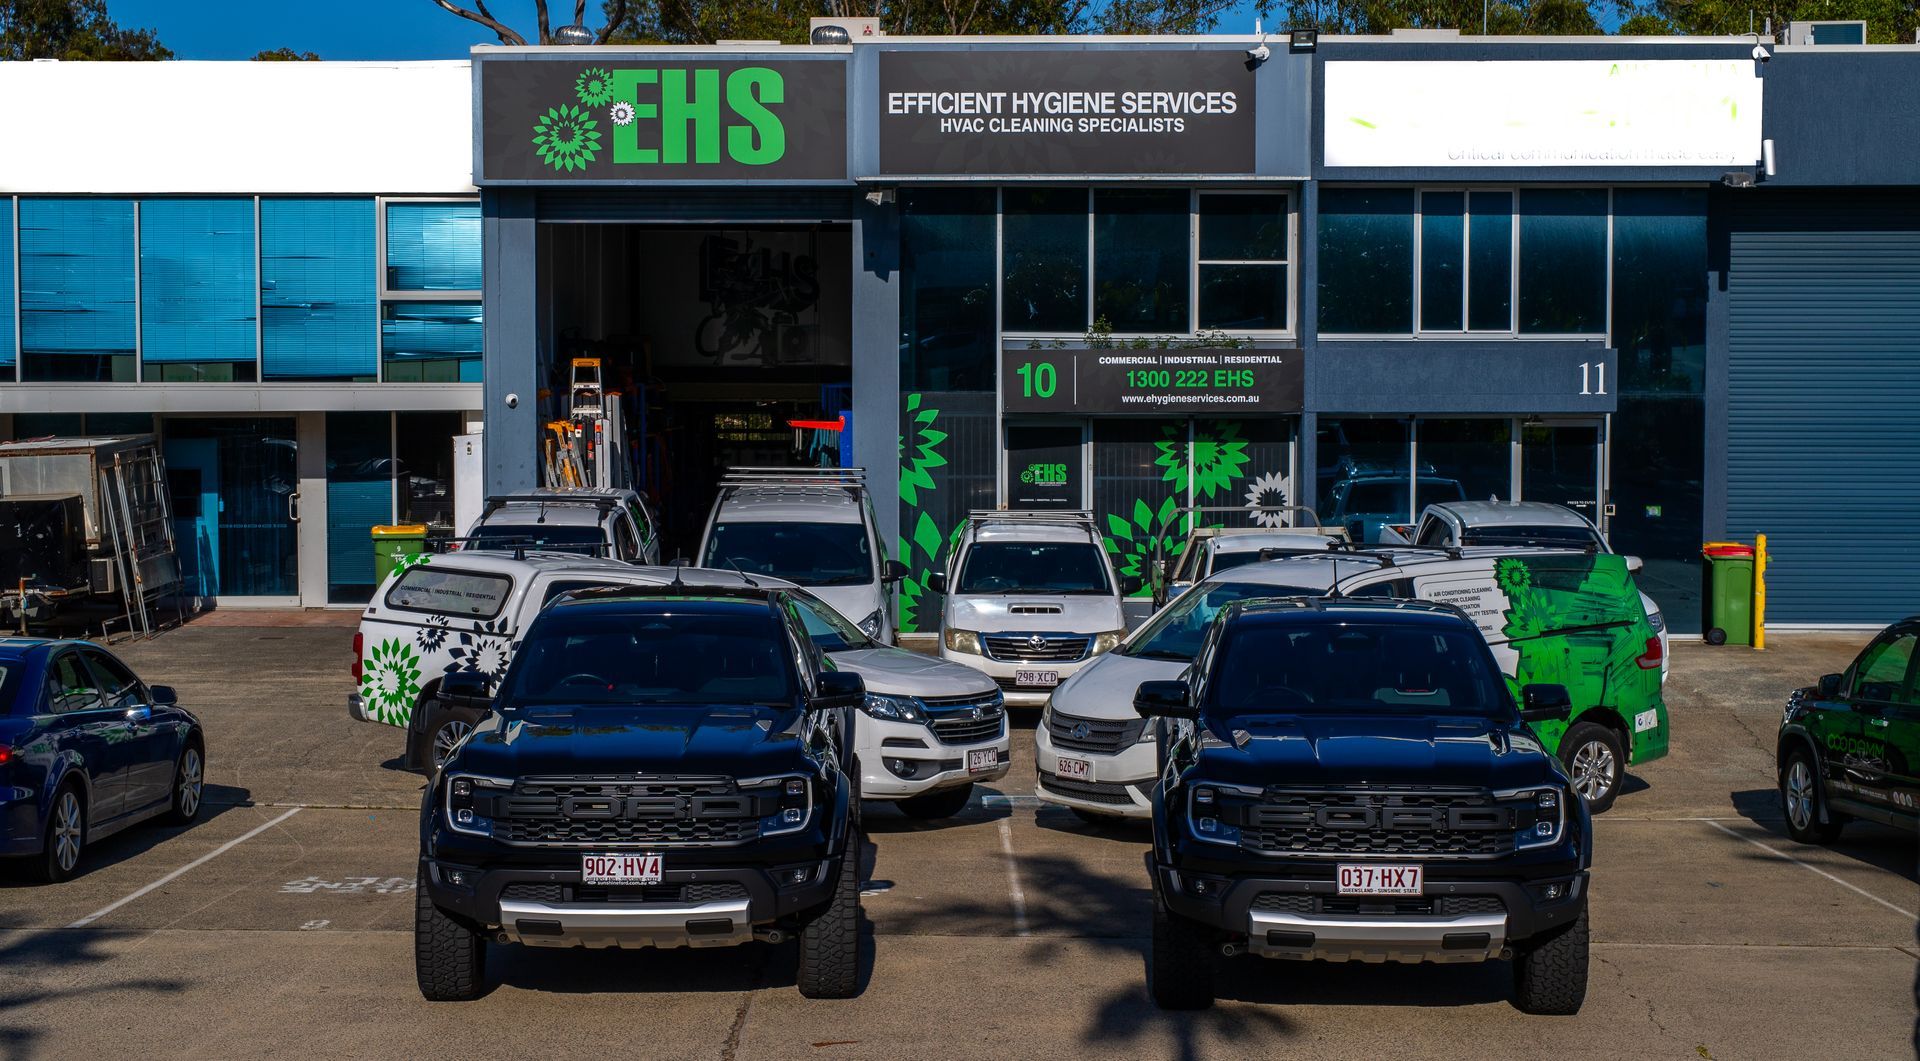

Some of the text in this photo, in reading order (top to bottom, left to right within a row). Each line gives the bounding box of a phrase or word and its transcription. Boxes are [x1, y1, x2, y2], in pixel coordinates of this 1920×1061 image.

[888, 92, 1238, 115] EFFICIENT HYGIENE SERVICES
[612, 67, 786, 165] EHS
[940, 118, 1185, 133] HVAC CLEANING SPECIALISTS
[1099, 355, 1282, 365] COMMERCIAL INDUSTRIAL RESIDENTIAL
[1016, 362, 1057, 398] 10
[1126, 370, 1254, 388] 1300 222 EHS
[1578, 362, 1608, 395] 11
[1121, 393, 1260, 404] www.ehygieneservices.com.au
[1034, 463, 1067, 482] EHS
[400, 585, 497, 601] COMMERCIAL INDUSTRIAL RESIDENTIAL
[1441, 588, 1472, 597] CONDITIONING
[1471, 586, 1493, 594] CLEANING
[1459, 595, 1481, 603] CLEANING
[1481, 608, 1499, 616] TESTING
[502, 795, 752, 820] FORD
[1245, 804, 1509, 831] FORD
